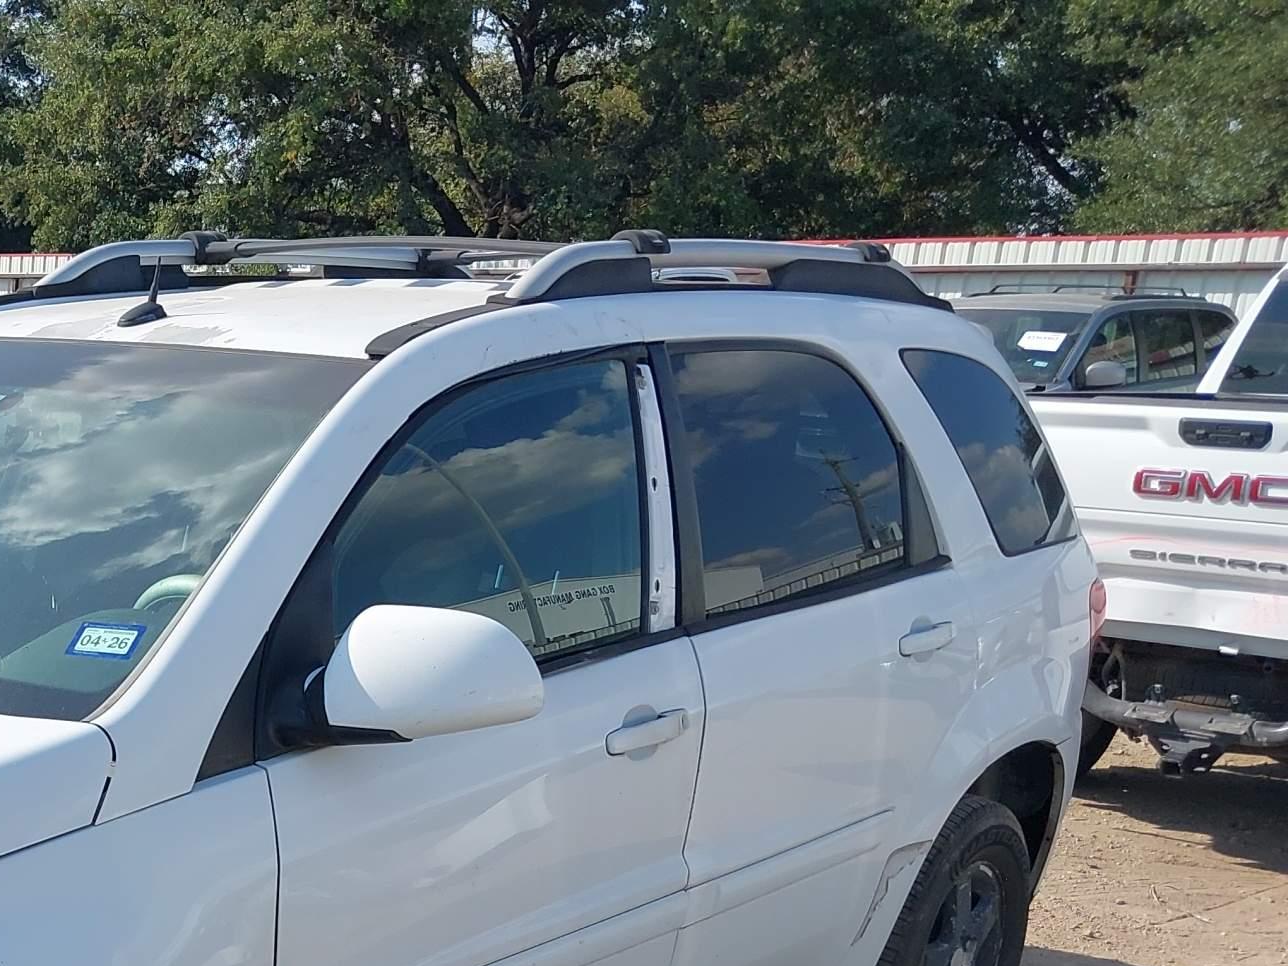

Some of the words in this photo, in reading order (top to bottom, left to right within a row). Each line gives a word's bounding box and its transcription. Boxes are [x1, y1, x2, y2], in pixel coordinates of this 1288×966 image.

[1129, 549, 1288, 574] SIERRA
[79, 634, 102, 648] 04
[107, 636, 131, 650] 26
